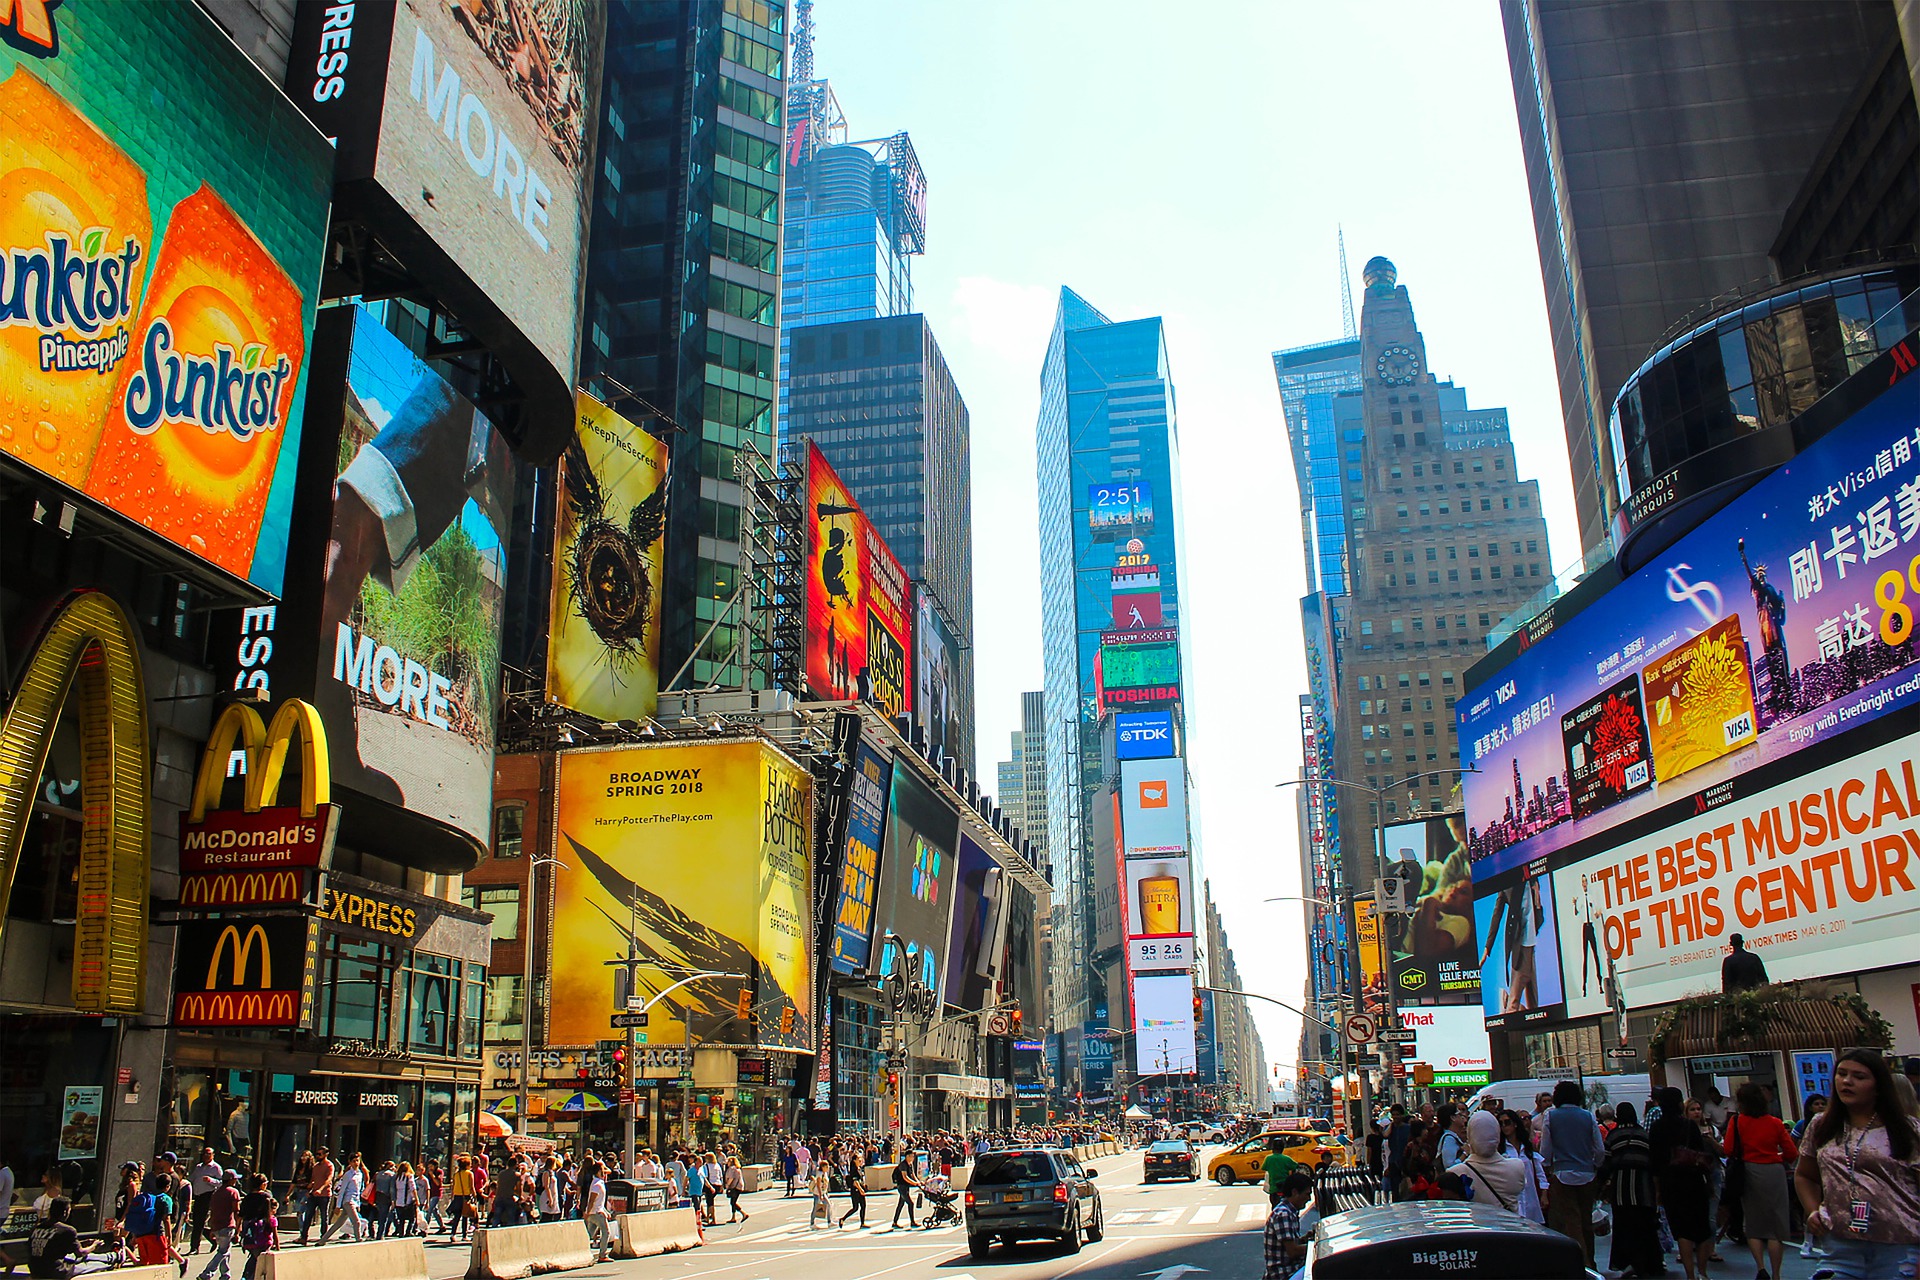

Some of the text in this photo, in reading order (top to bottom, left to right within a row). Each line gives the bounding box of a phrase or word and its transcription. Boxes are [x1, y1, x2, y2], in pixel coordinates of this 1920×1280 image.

[410, 26, 553, 254] MORE
[40, 328, 129, 374] Pineapple
[125, 321, 290, 436] Sunkist
[580, 414, 658, 470] #KeepTheSecrets
[1097, 486, 1141, 507] 2:51
[1628, 469, 1680, 511] MARRIOTT
[1631, 488, 1675, 525] MARQUIS
[1118, 553, 1151, 567] 2017
[1111, 564, 1159, 576] TOSHIBA
[1528, 607, 1555, 633] MARRIOTT
[1529, 620, 1554, 643] MARQUIS
[333, 621, 451, 732] MORE
[1104, 686, 1179, 703] TOSHIBA
[1494, 680, 1517, 705] VISA
[725, 714, 761, 724] LAMAR
[1789, 722, 1815, 743] Enjoy
[1815, 712, 1838, 732] with
[1838, 689, 1895, 722] Everbright
[1130, 727, 1168, 741] TDK
[1725, 717, 1751, 739] VISA
[609, 768, 702, 784] BROADWAY
[1627, 766, 1647, 784] VISA
[606, 782, 703, 798] SPRING 2018
[767, 764, 807, 826] HARRY
[1706, 781, 1734, 798] MARRIOTT
[1706, 792, 1732, 808] MARQUIS
[594, 812, 713, 827] HarryPotterThePlay.com
[1655, 822, 1736, 893] BEST
[1741, 759, 1920, 867] MUSICAL
[184, 824, 317, 850] McDonald's
[764, 800, 809, 862] POTTER
[204, 849, 292, 864] Restaurant
[846, 835, 878, 879] COME
[842, 863, 875, 907] FROM
[1143, 892, 1178, 904] ULTRA
[315, 887, 417, 938] EXPRESS
[771, 904, 801, 924] BROADWAY
[838, 895, 872, 935] AWAY
[770, 918, 790, 935] SPRING
[1358, 922, 1373, 932] LION
[1603, 908, 1642, 961] OF
[1648, 886, 1725, 949] THIS
[1358, 931, 1377, 944] KING
[1669, 955, 1683, 966] BEN
[1683, 949, 1718, 965] BRANTLEY
[1719, 944, 1734, 955] THE
[1753, 935, 1774, 949] YORK
[1775, 929, 1798, 944] TIMES
[1801, 925, 1818, 939] MAY
[1829, 919, 1847, 933] 2011
[1141, 944, 1182, 955] 95 2.6
[1442, 961, 1460, 972] LOVE
[1402, 973, 1423, 985] CMT
[1439, 970, 1462, 982] KELLIE
[1440, 982, 1472, 991] THURSDAYS
[621, 1016, 645, 1025] ONE WAY
[1387, 1032, 1400, 1040] ONE
[1458, 1057, 1487, 1066] Pinterest
[555, 1080, 585, 1089] Canon
[1451, 1074, 1488, 1084] FRIENDS
[294, 1090, 399, 1107] EXPRESS EXPRESS
[14, 1213, 38, 1223] SALES
[31, 1227, 58, 1240] KISS
[1412, 1248, 1479, 1266] BigBelly
[1439, 1260, 1471, 1271] SOLAR
